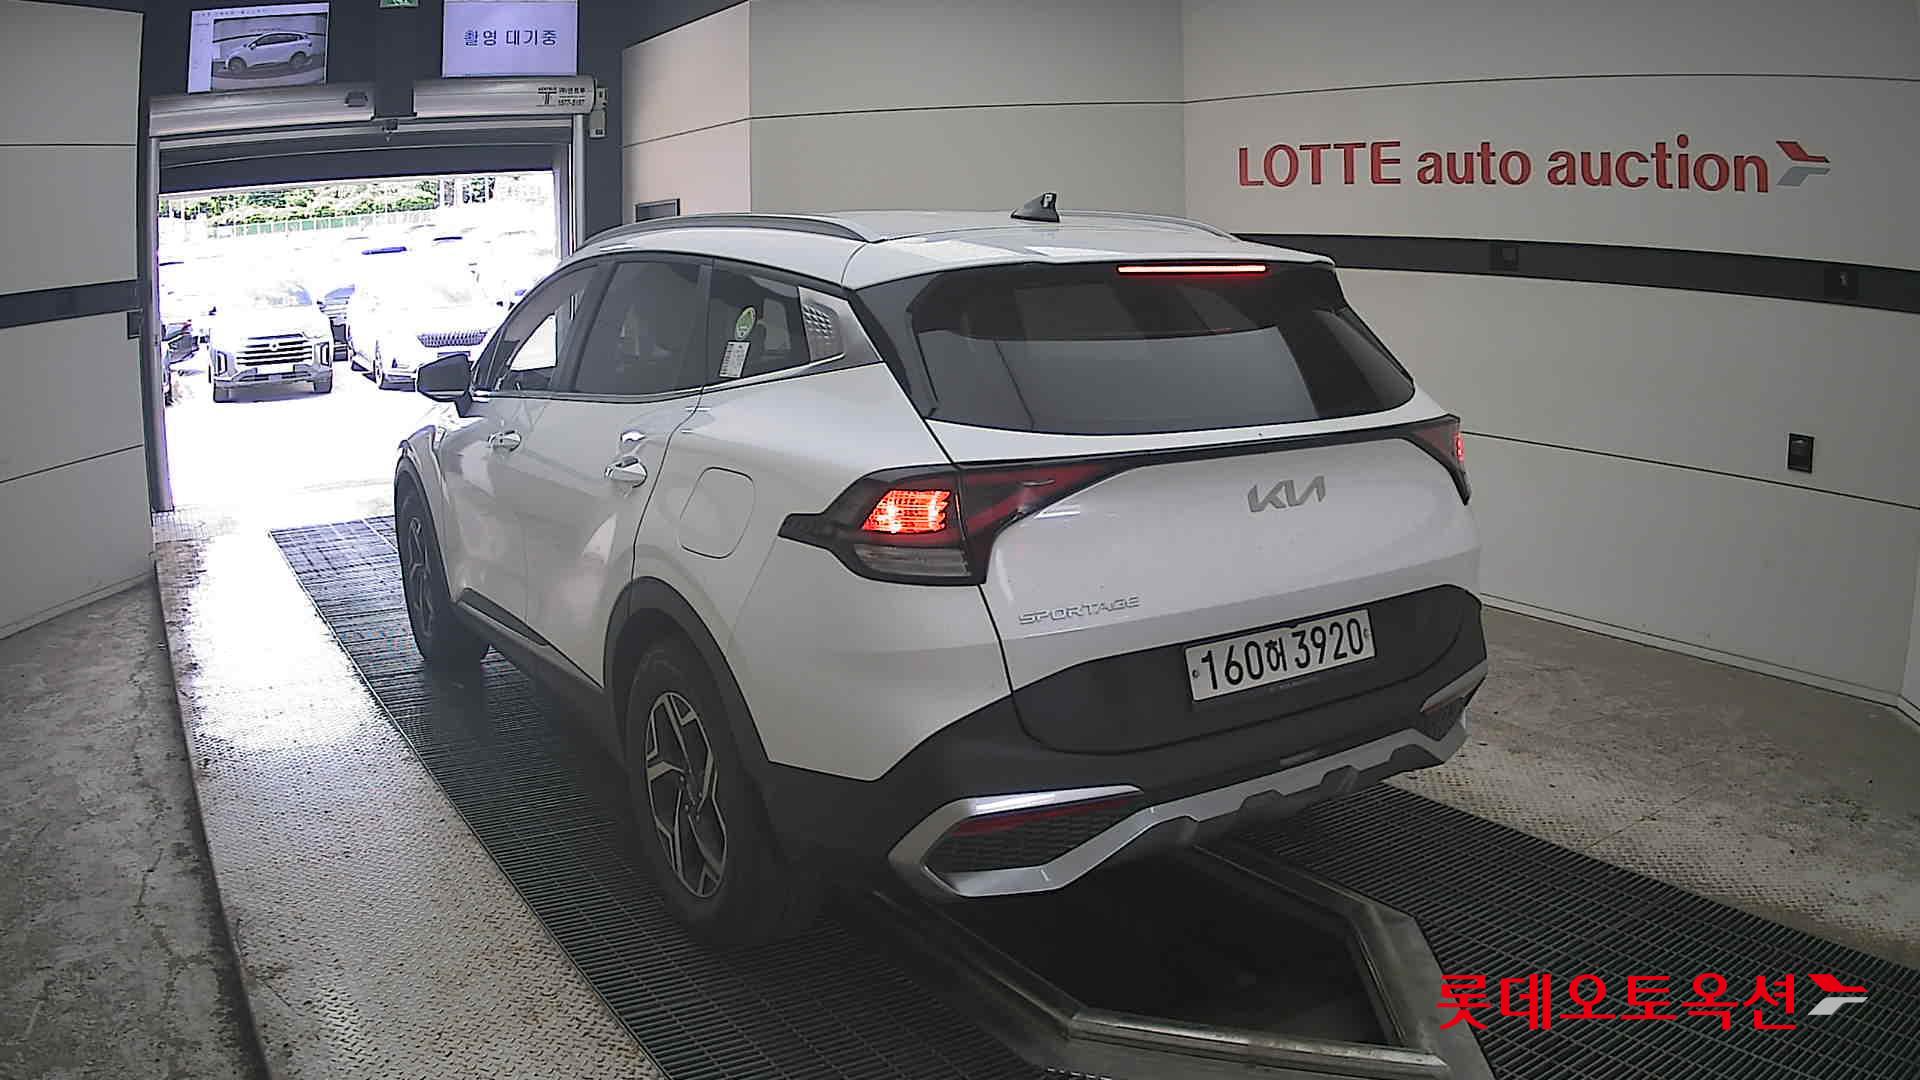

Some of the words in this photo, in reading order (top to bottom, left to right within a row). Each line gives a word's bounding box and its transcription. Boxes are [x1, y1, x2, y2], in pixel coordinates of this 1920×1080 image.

[506, 29, 557, 46] 대기중
[1239, 141, 1401, 187] LOTTE
[1417, 142, 1531, 185] auto
[1548, 134, 1768, 193] auction
[1248, 475, 1326, 512] KIA
[1019, 595, 1140, 625] SPORTAGE
